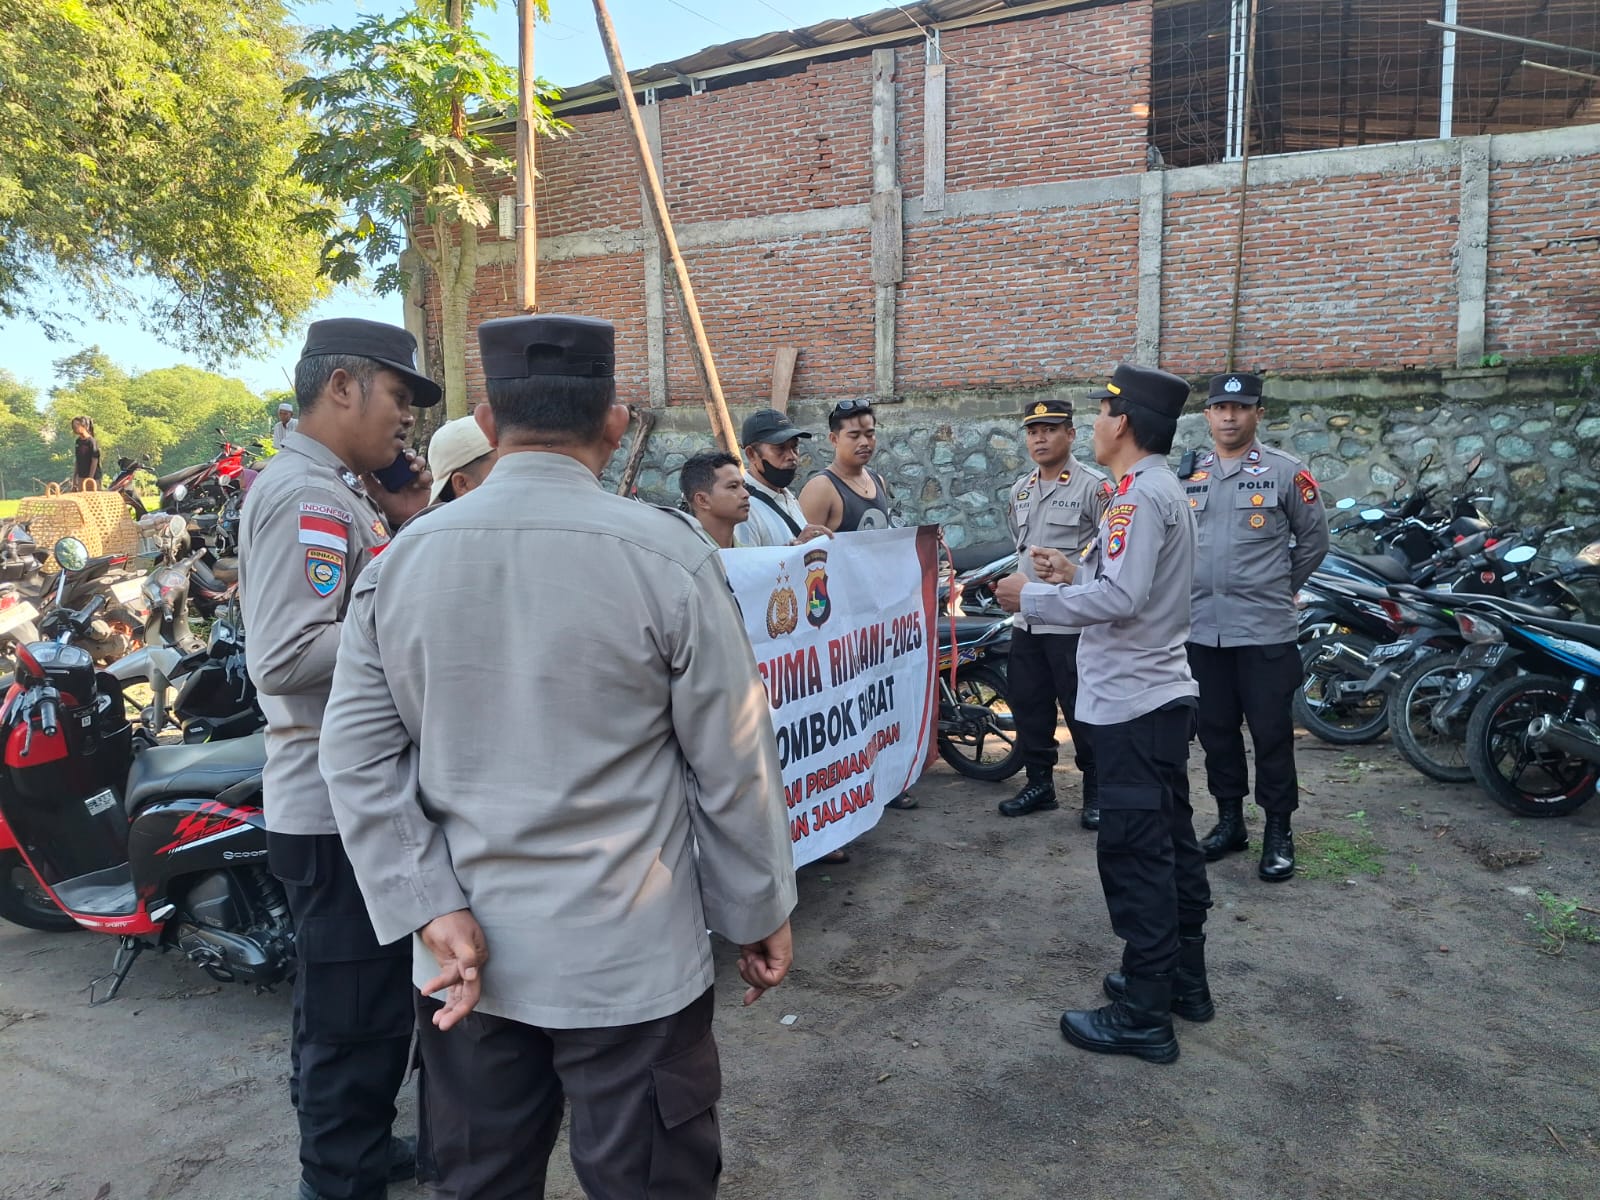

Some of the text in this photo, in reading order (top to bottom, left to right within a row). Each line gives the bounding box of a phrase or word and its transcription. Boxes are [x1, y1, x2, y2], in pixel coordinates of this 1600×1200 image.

[1237, 480, 1275, 490] POLRI
[303, 503, 350, 521] INDONESIA
[1051, 500, 1080, 509] POLRI
[310, 551, 340, 563] BINMAS
[876, 721, 900, 753] DAN
[812, 776, 875, 832] JALANA
